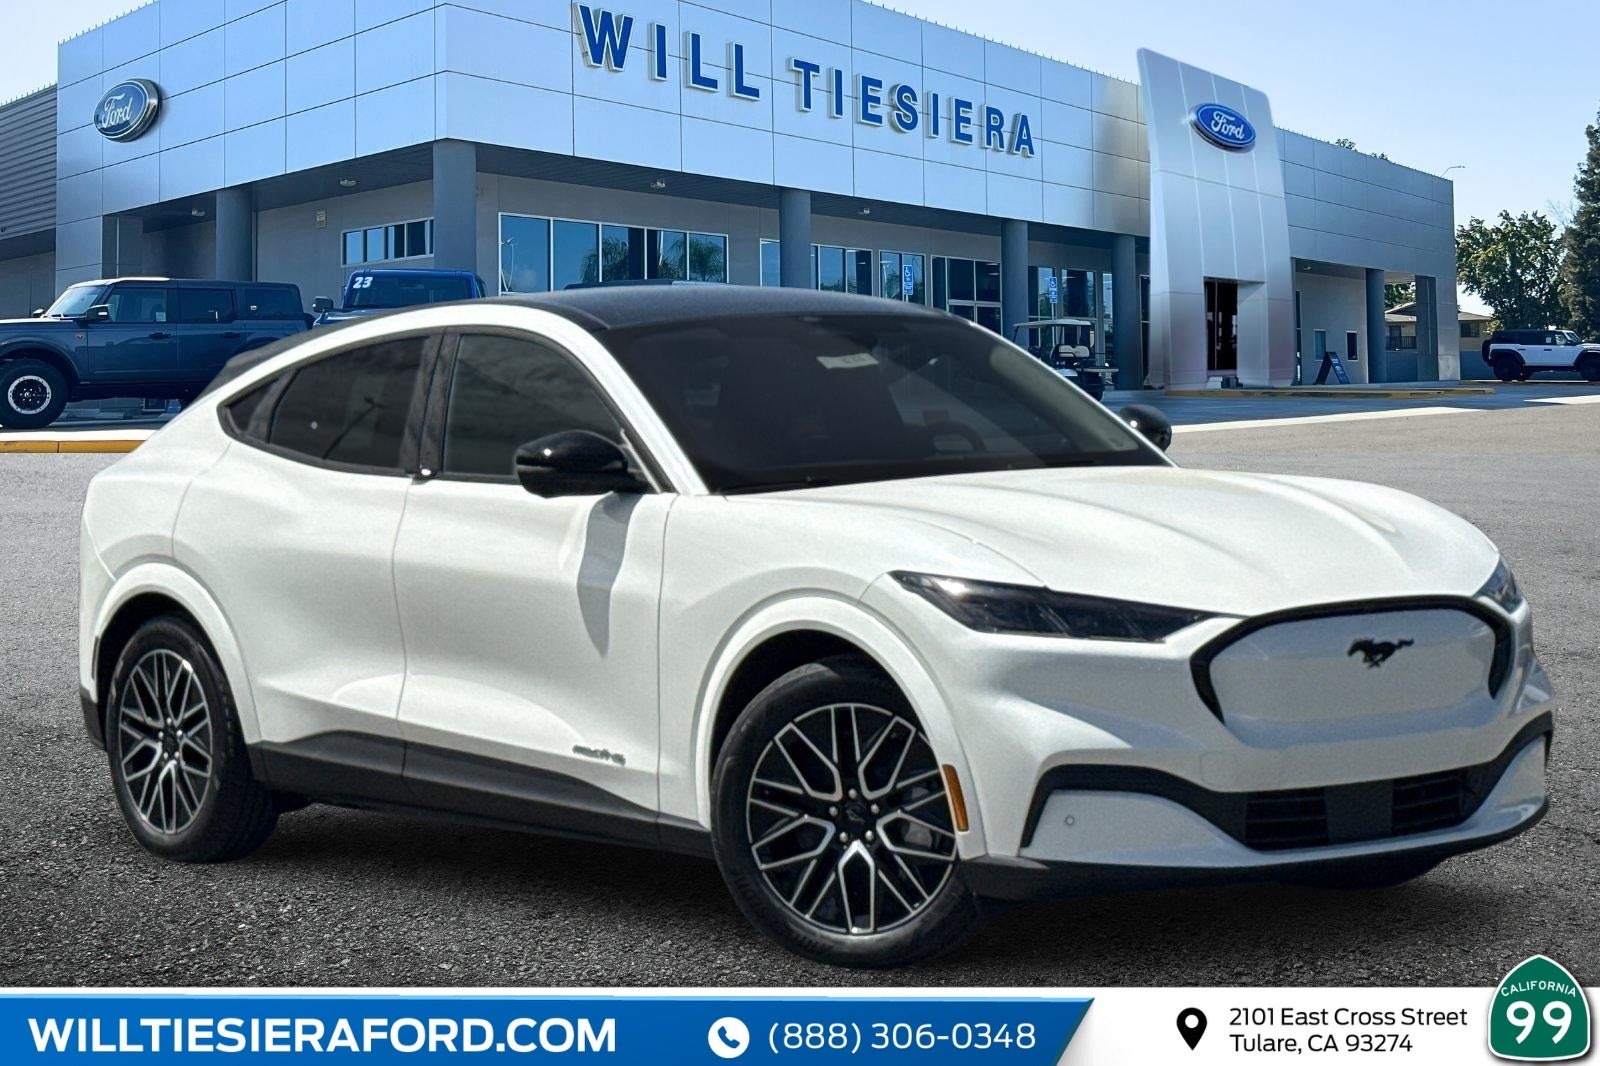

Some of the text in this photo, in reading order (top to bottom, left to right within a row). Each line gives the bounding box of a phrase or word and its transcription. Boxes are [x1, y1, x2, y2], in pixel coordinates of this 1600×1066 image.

[575, 3, 1036, 157] WILL TIESIERA
[101, 93, 133, 129] Ford
[1210, 110, 1245, 140] Ford
[352, 276, 374, 289] 23
